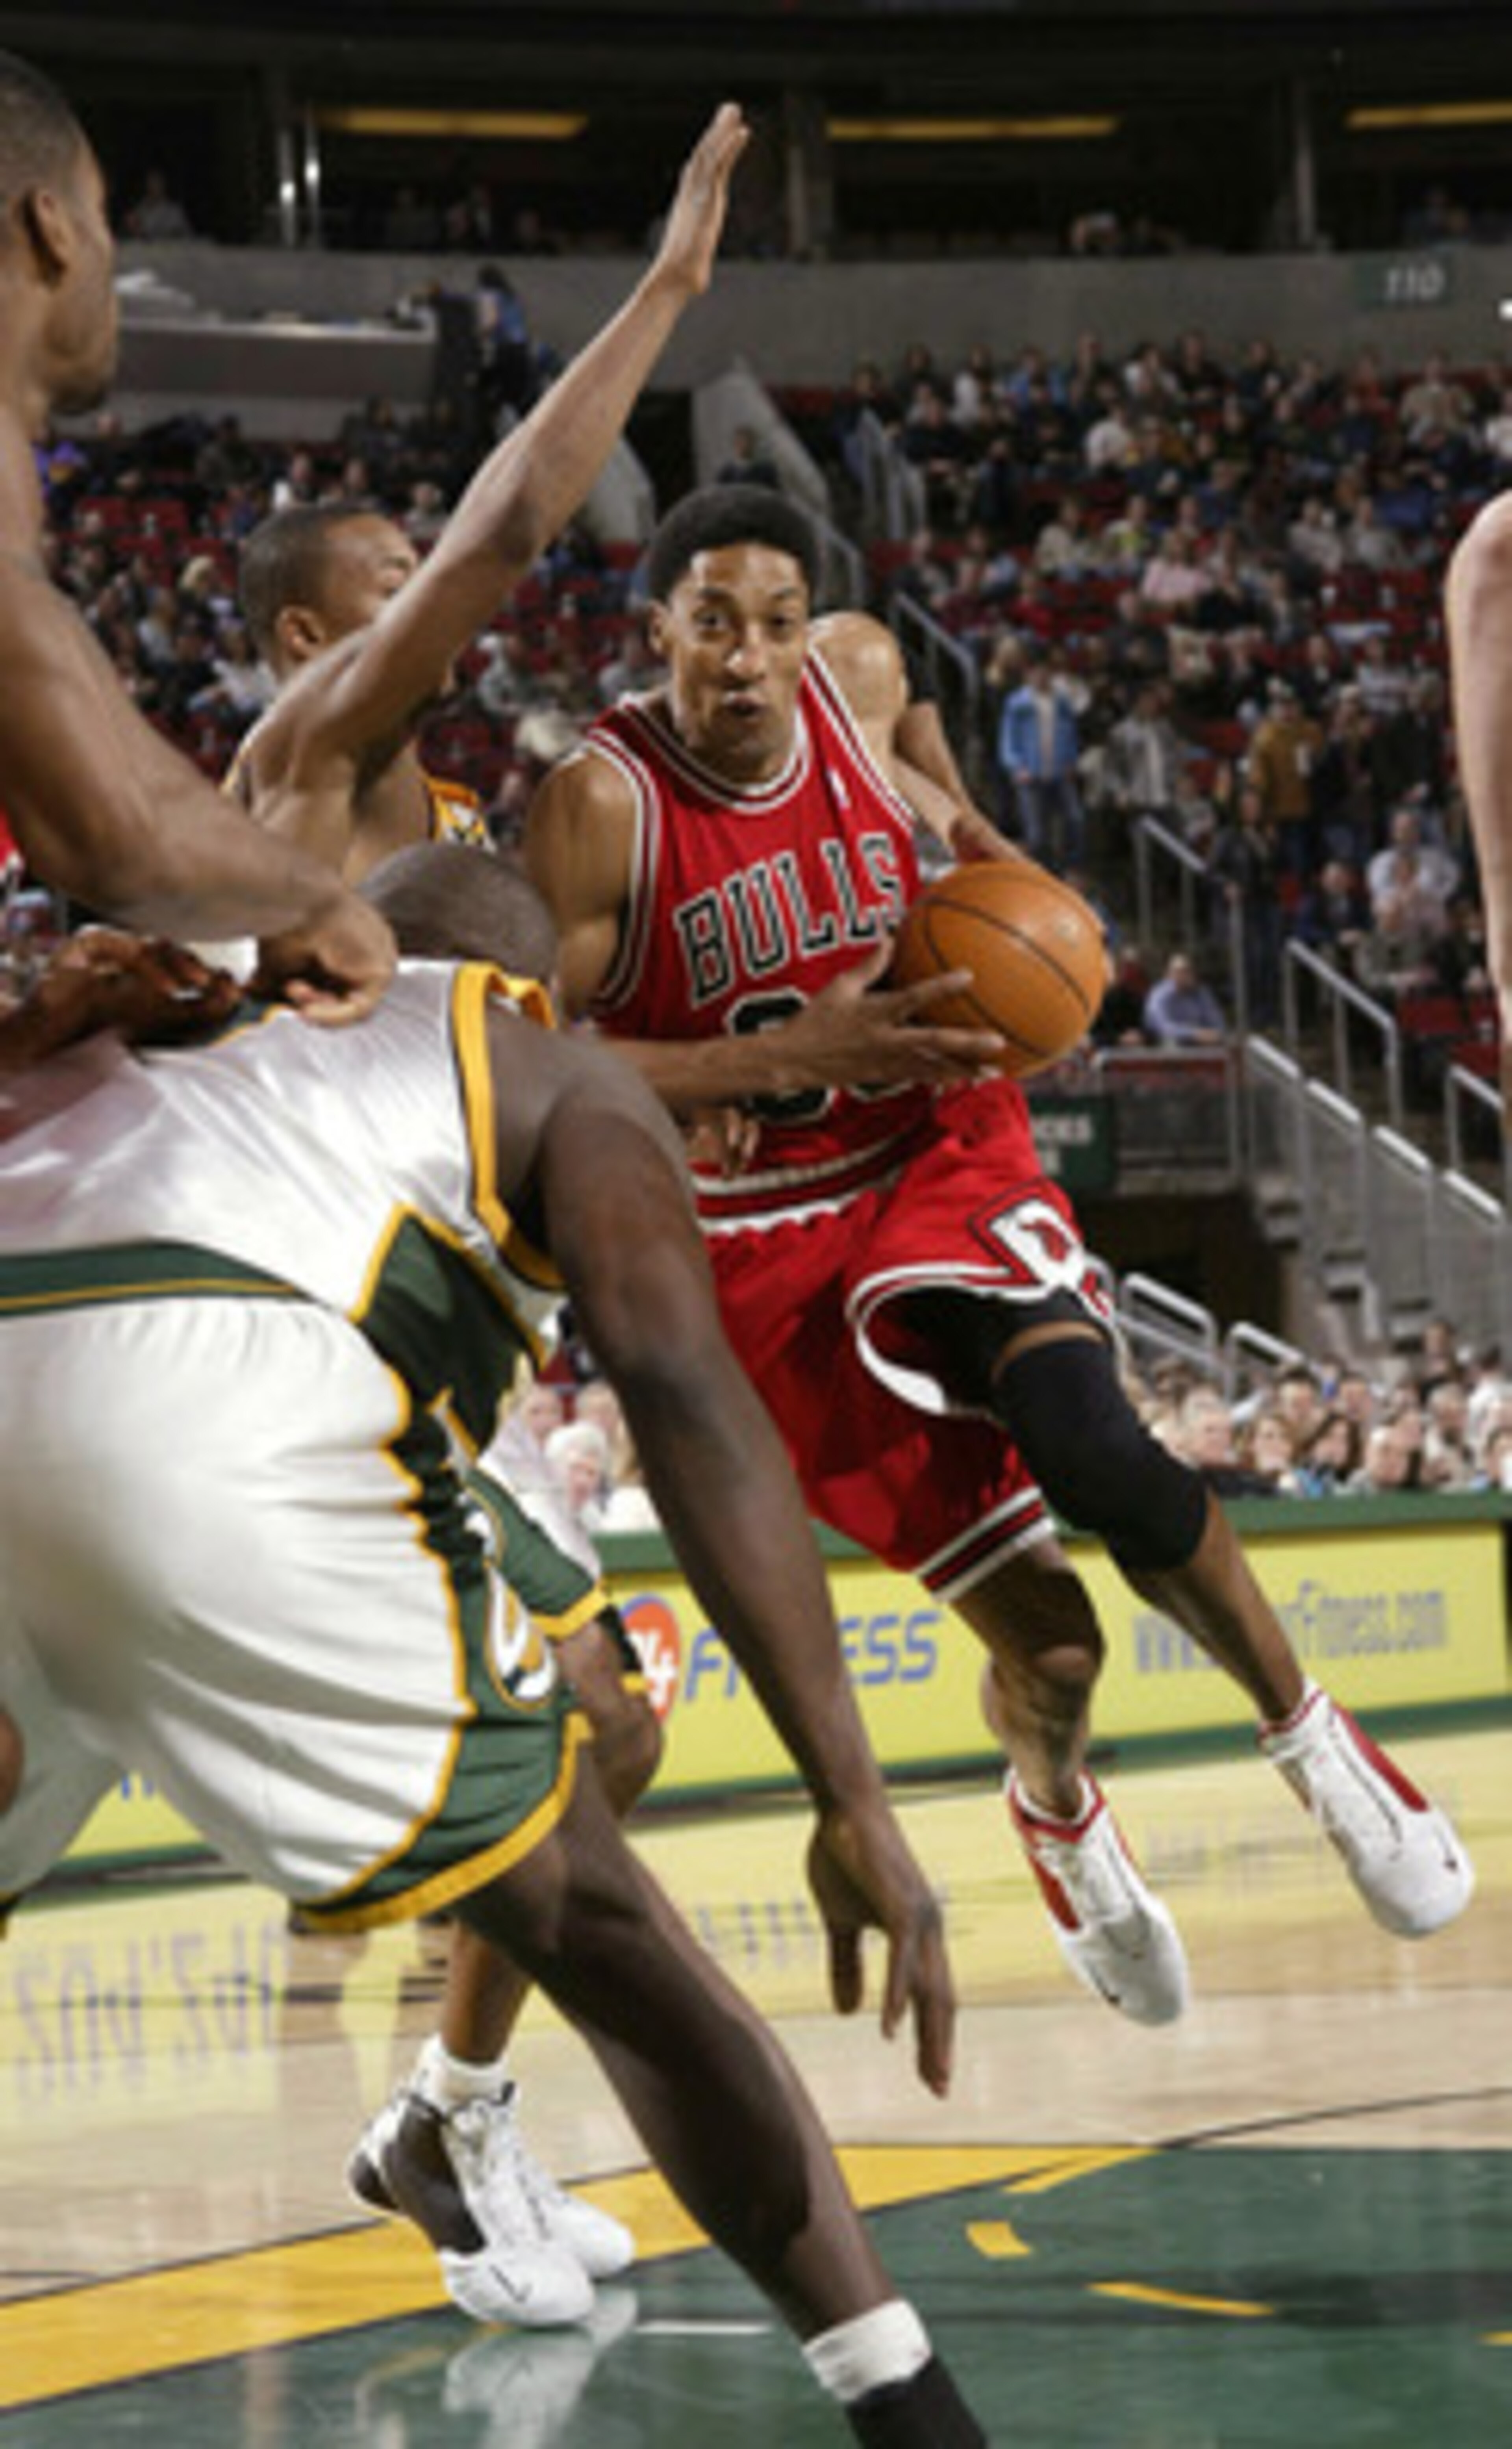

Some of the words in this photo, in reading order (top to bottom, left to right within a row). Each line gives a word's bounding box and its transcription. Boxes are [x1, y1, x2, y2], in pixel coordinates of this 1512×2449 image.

[1385, 263, 1446, 300] 110
[674, 831, 904, 1009] BULLS
[684, 1610, 941, 1702] FIESS
